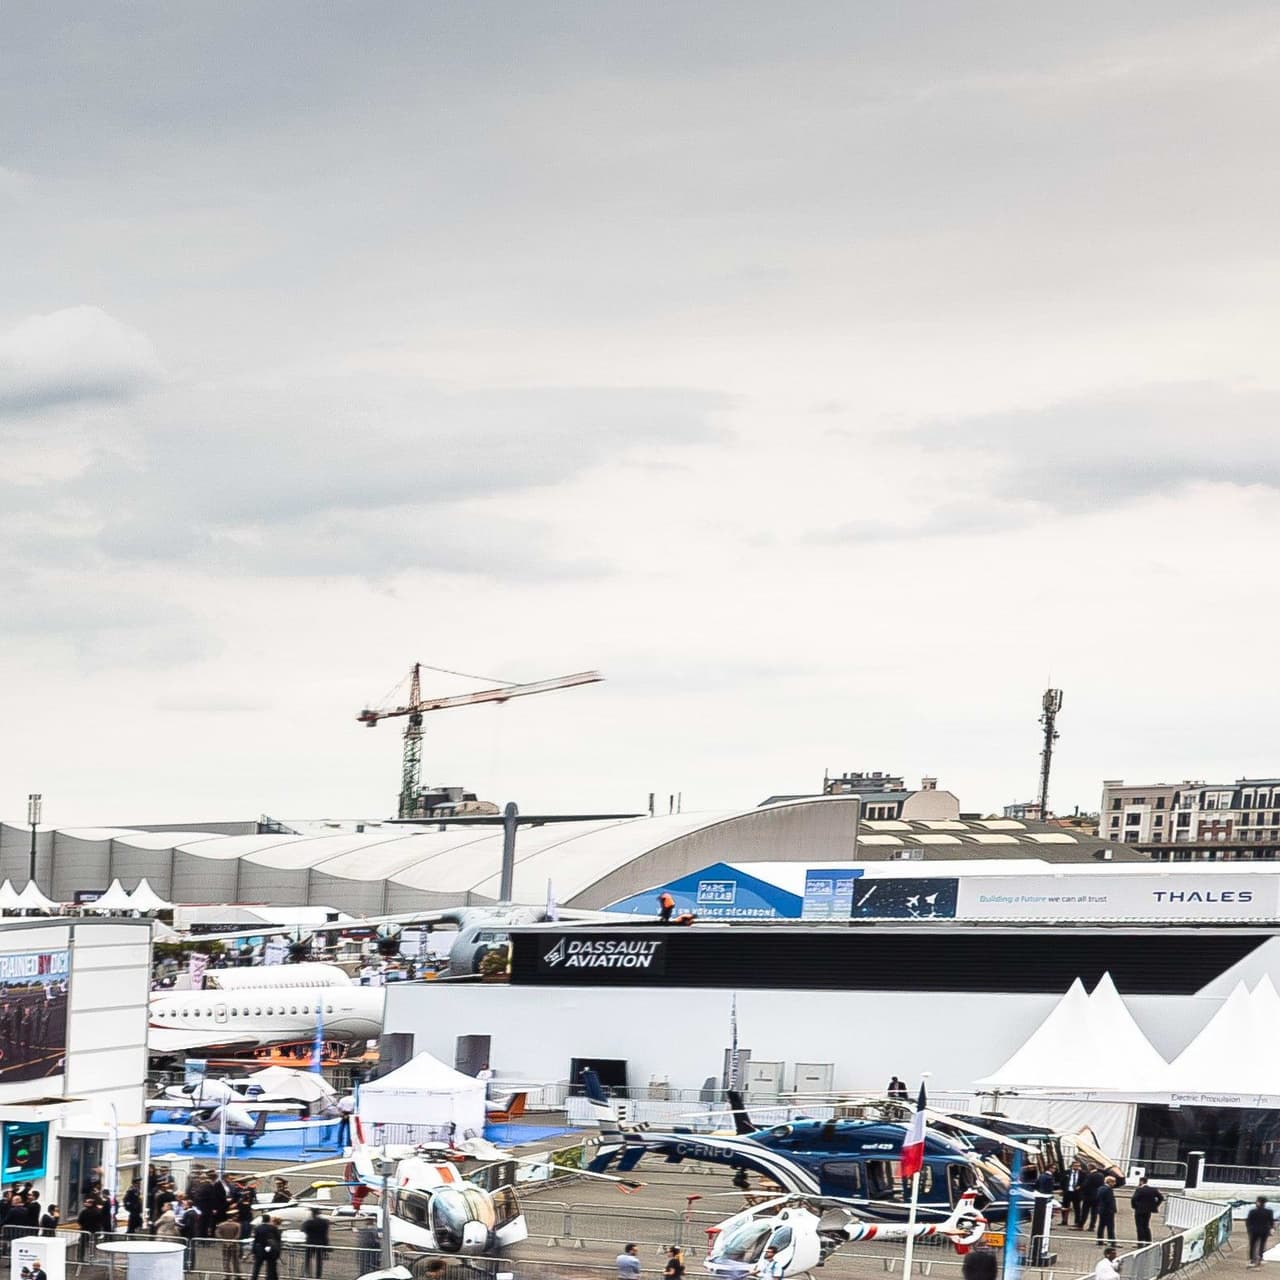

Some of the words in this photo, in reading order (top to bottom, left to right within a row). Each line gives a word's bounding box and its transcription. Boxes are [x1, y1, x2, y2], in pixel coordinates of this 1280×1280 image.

[1088, 895, 1107, 903] trust
[1153, 891, 1253, 902] THALES
[567, 940, 662, 954] DASSAULT
[565, 954, 653, 968] AVIATION
